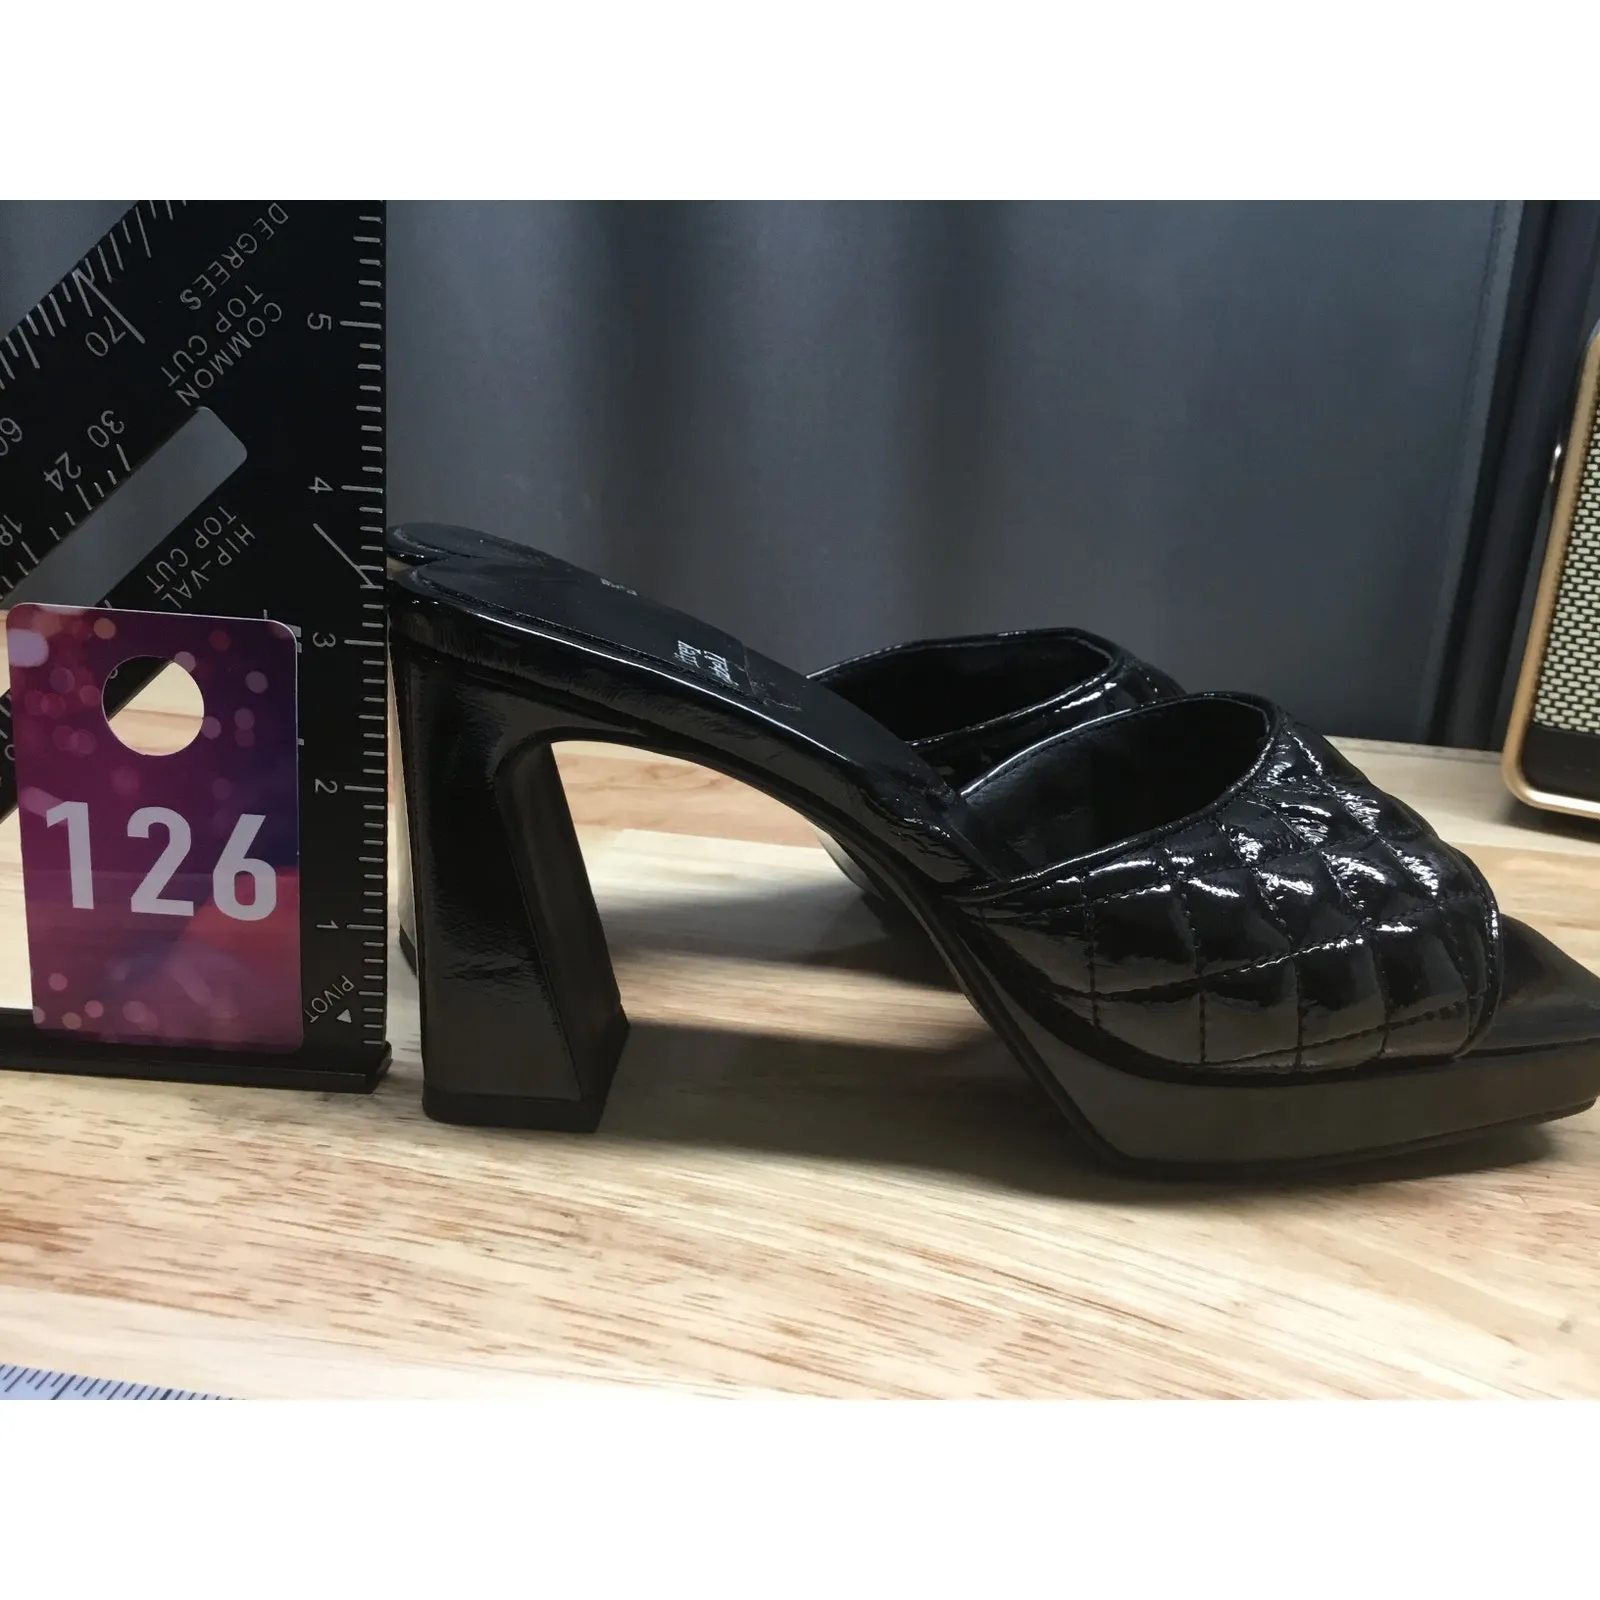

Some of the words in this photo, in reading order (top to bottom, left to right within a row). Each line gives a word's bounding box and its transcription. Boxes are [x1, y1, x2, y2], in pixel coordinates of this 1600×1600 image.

[179, 202, 289, 311] DEGREES
[215, 284, 264, 333] TOP
[306, 312, 332, 332] 5
[85, 315, 126, 357] 70
[174, 302, 283, 407] COMMON
[160, 335, 208, 387] CUT
[87, 410, 125, 448] 30
[43, 451, 82, 492] 24
[308, 476, 334, 494] 4
[194, 505, 237, 549] TOP
[146, 548, 189, 594] CUT
[160, 523, 256, 609] HIP-VAL
[312, 631, 337, 648] 3
[314, 777, 339, 795] 2
[46, 800, 278, 921] 126
[304, 974, 355, 1023] PIVOT
